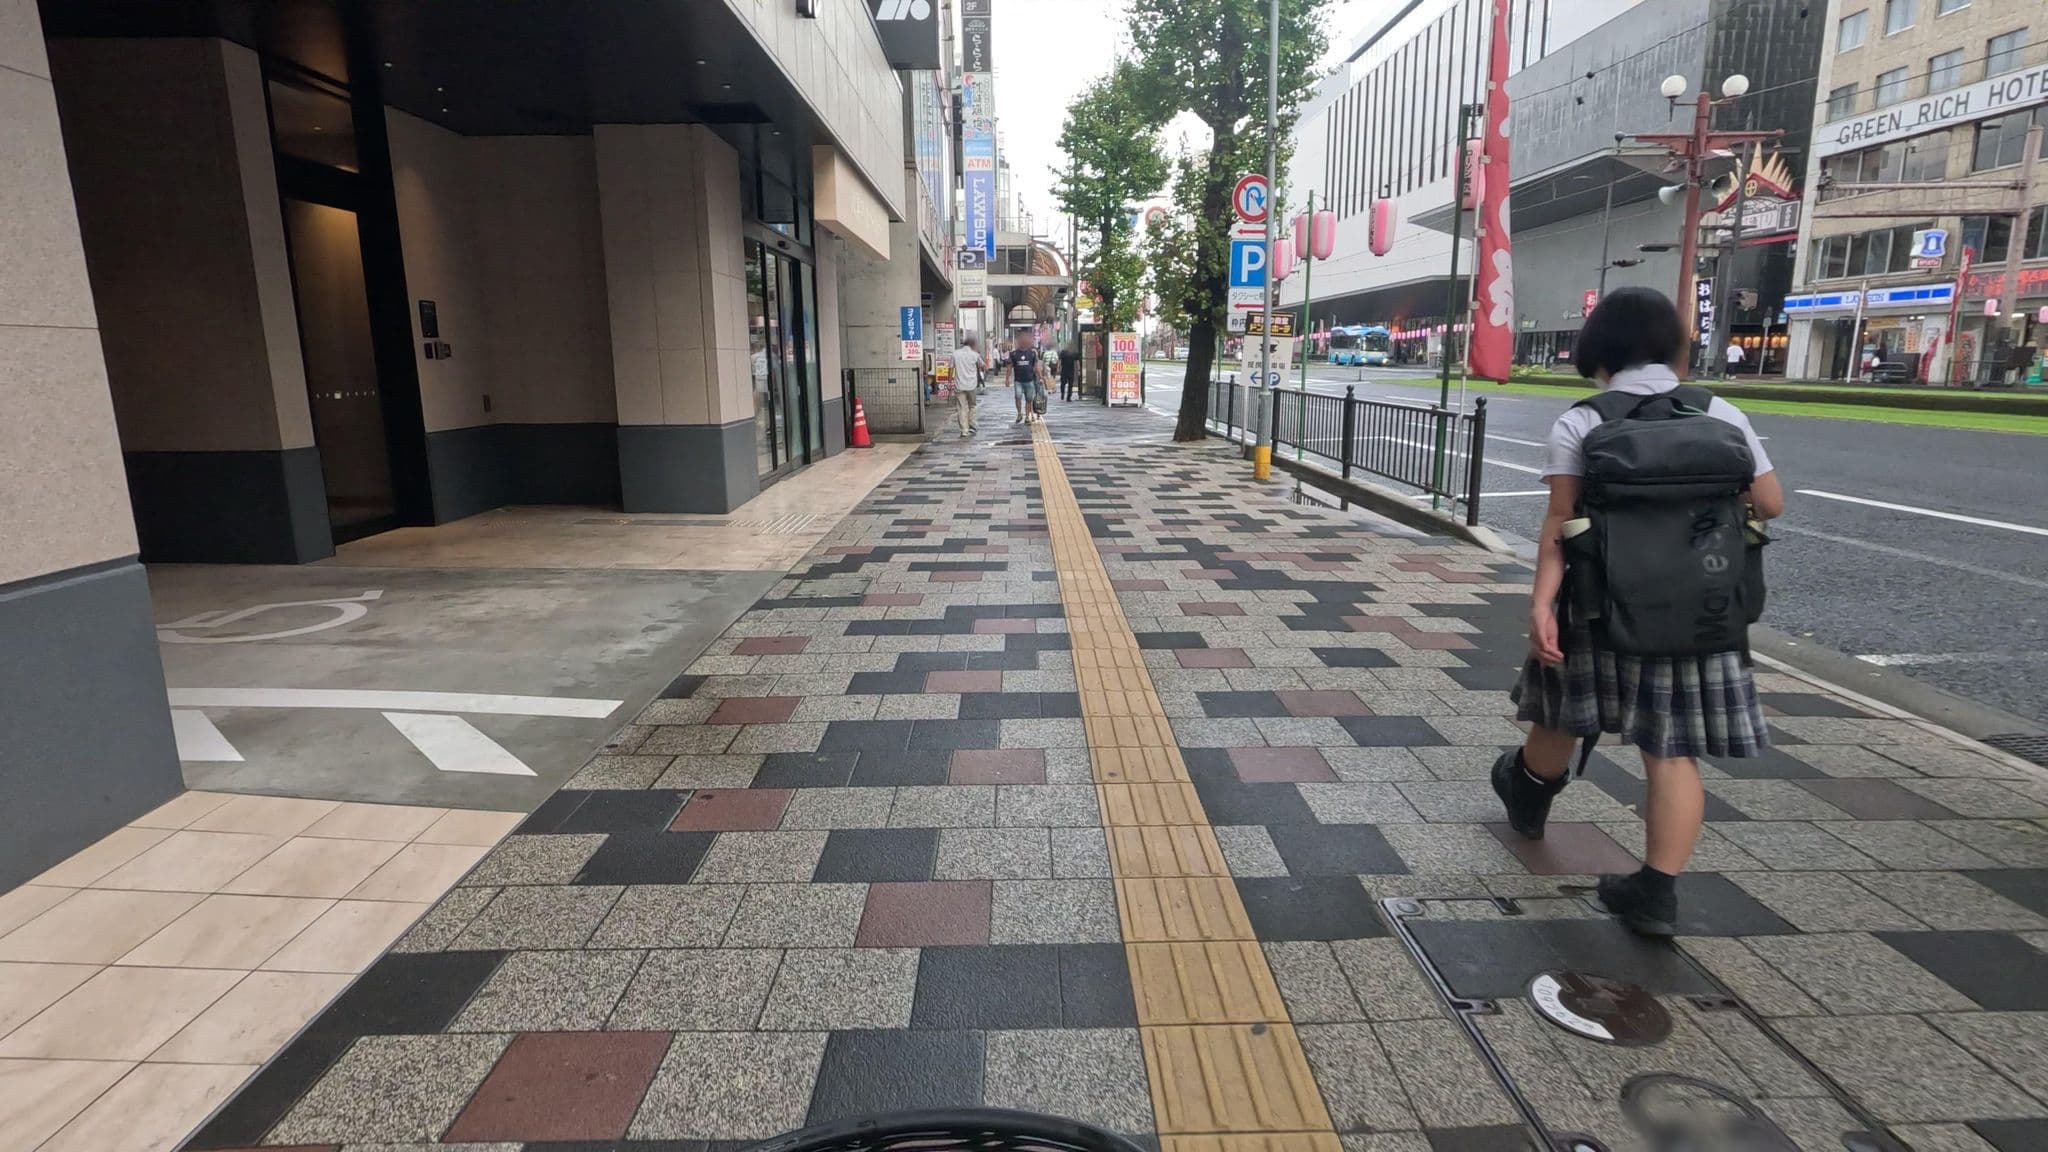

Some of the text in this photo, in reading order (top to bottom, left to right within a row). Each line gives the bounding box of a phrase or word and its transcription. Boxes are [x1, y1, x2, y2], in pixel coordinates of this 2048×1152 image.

[966, 1, 977, 11] 2F
[1839, 110, 1902, 145] GREEN
[1918, 91, 1970, 125] RICH
[967, 158, 991, 168] ATM
[973, 178, 987, 250] LAWSON
[1241, 245, 1265, 283] P
